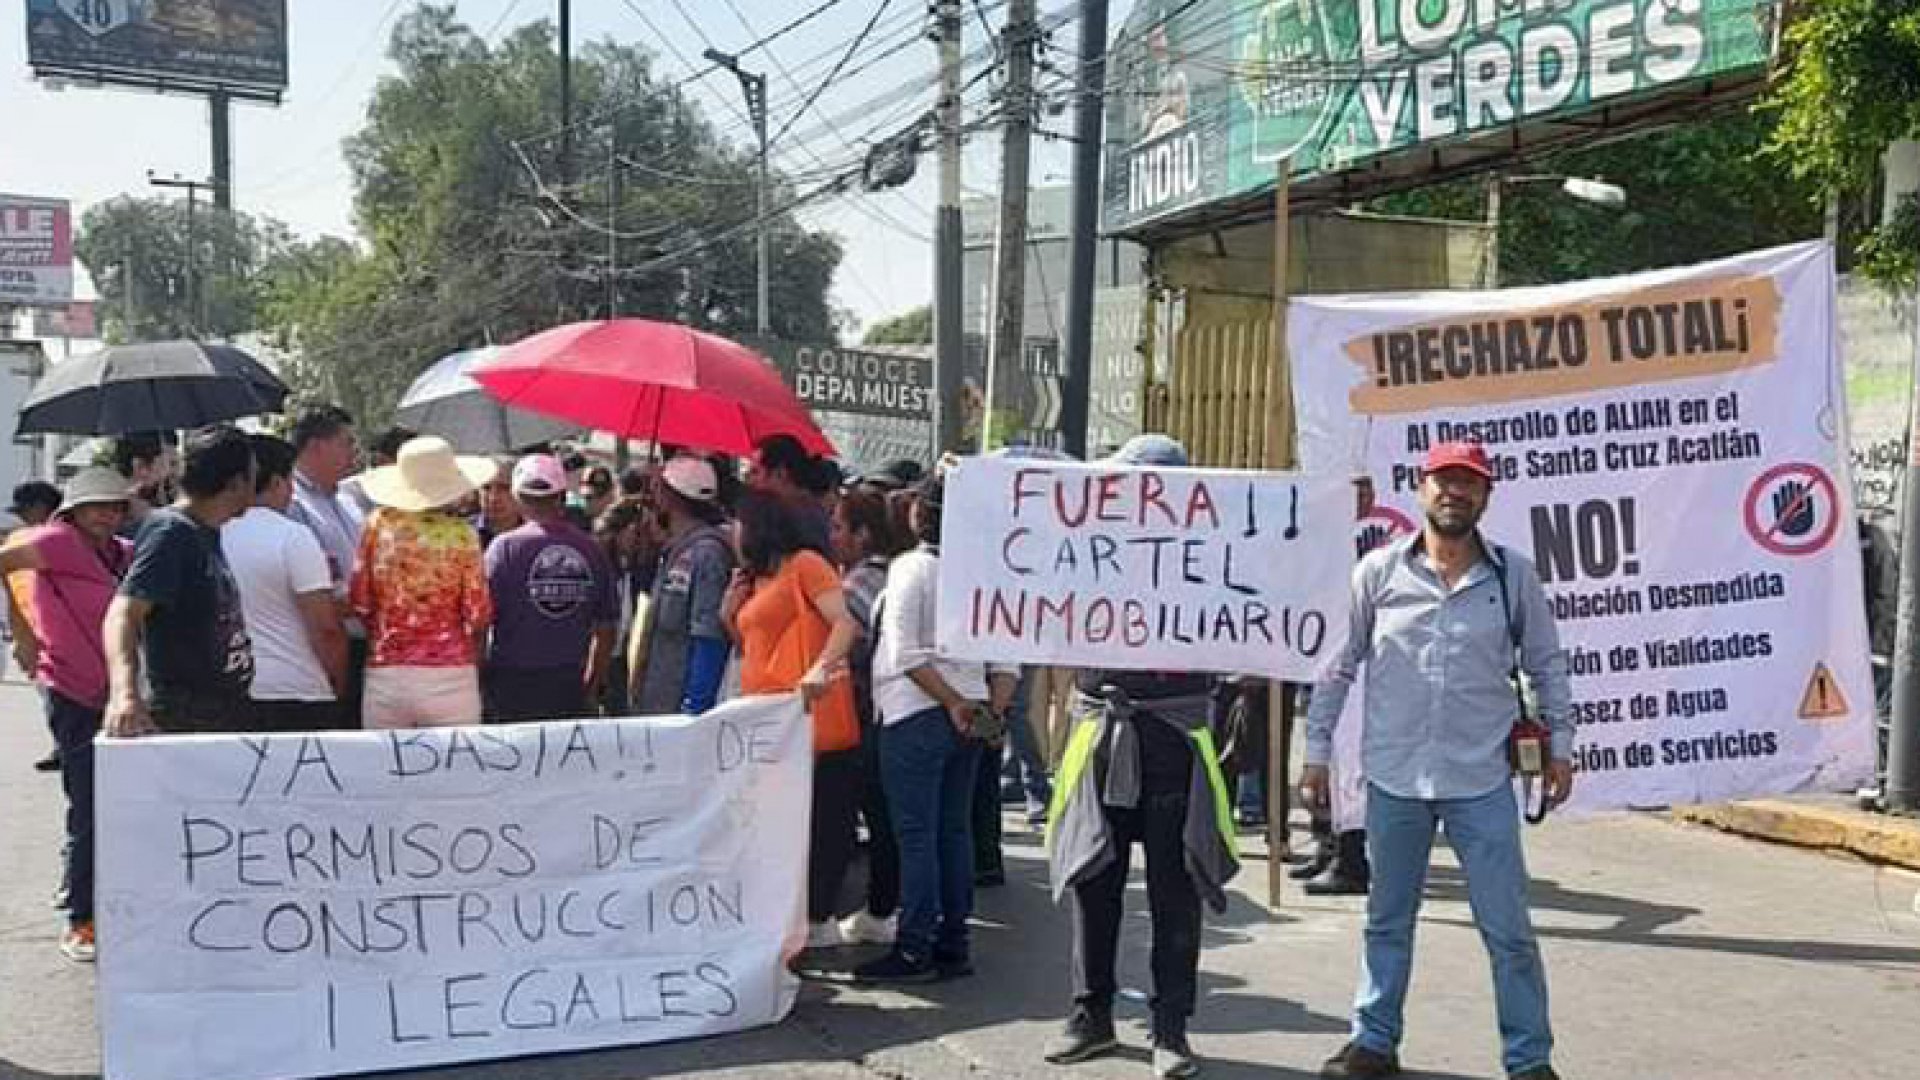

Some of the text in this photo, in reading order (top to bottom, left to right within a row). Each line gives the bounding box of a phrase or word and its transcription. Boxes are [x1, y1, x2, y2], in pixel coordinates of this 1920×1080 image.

[1360, 0, 1704, 149] VERDES
[1128, 131, 1199, 213] INDIO
[796, 347, 918, 385] CONOCE
[796, 373, 856, 404] DEPA
[1406, 421, 1429, 453] Al
[1566, 407, 1598, 435] de
[1604, 400, 1671, 433] ALIAH
[1679, 402, 1709, 423] en
[1715, 391, 1739, 421] el
[1526, 445, 1598, 479] Santa
[1604, 439, 1659, 471] Cruz
[1665, 430, 1761, 466] Acatlán
[1002, 526, 1261, 595] CARTEL
[1530, 496, 1640, 584] NO!
[971, 586, 1327, 658] INMOBILIARIO
[1648, 572, 1785, 611] Desmedida
[1609, 644, 1640, 671] de
[1644, 631, 1773, 669] Vialidades
[1630, 693, 1659, 721] de
[1666, 686, 1729, 719] Agua
[237, 736, 343, 806] YA
[716, 721, 784, 770] DE
[1624, 741, 1655, 769] de
[1660, 728, 1778, 766] Servicios
[181, 812, 672, 887] PERMISOS DE
[188, 881, 745, 958] CONSTRUCCION
